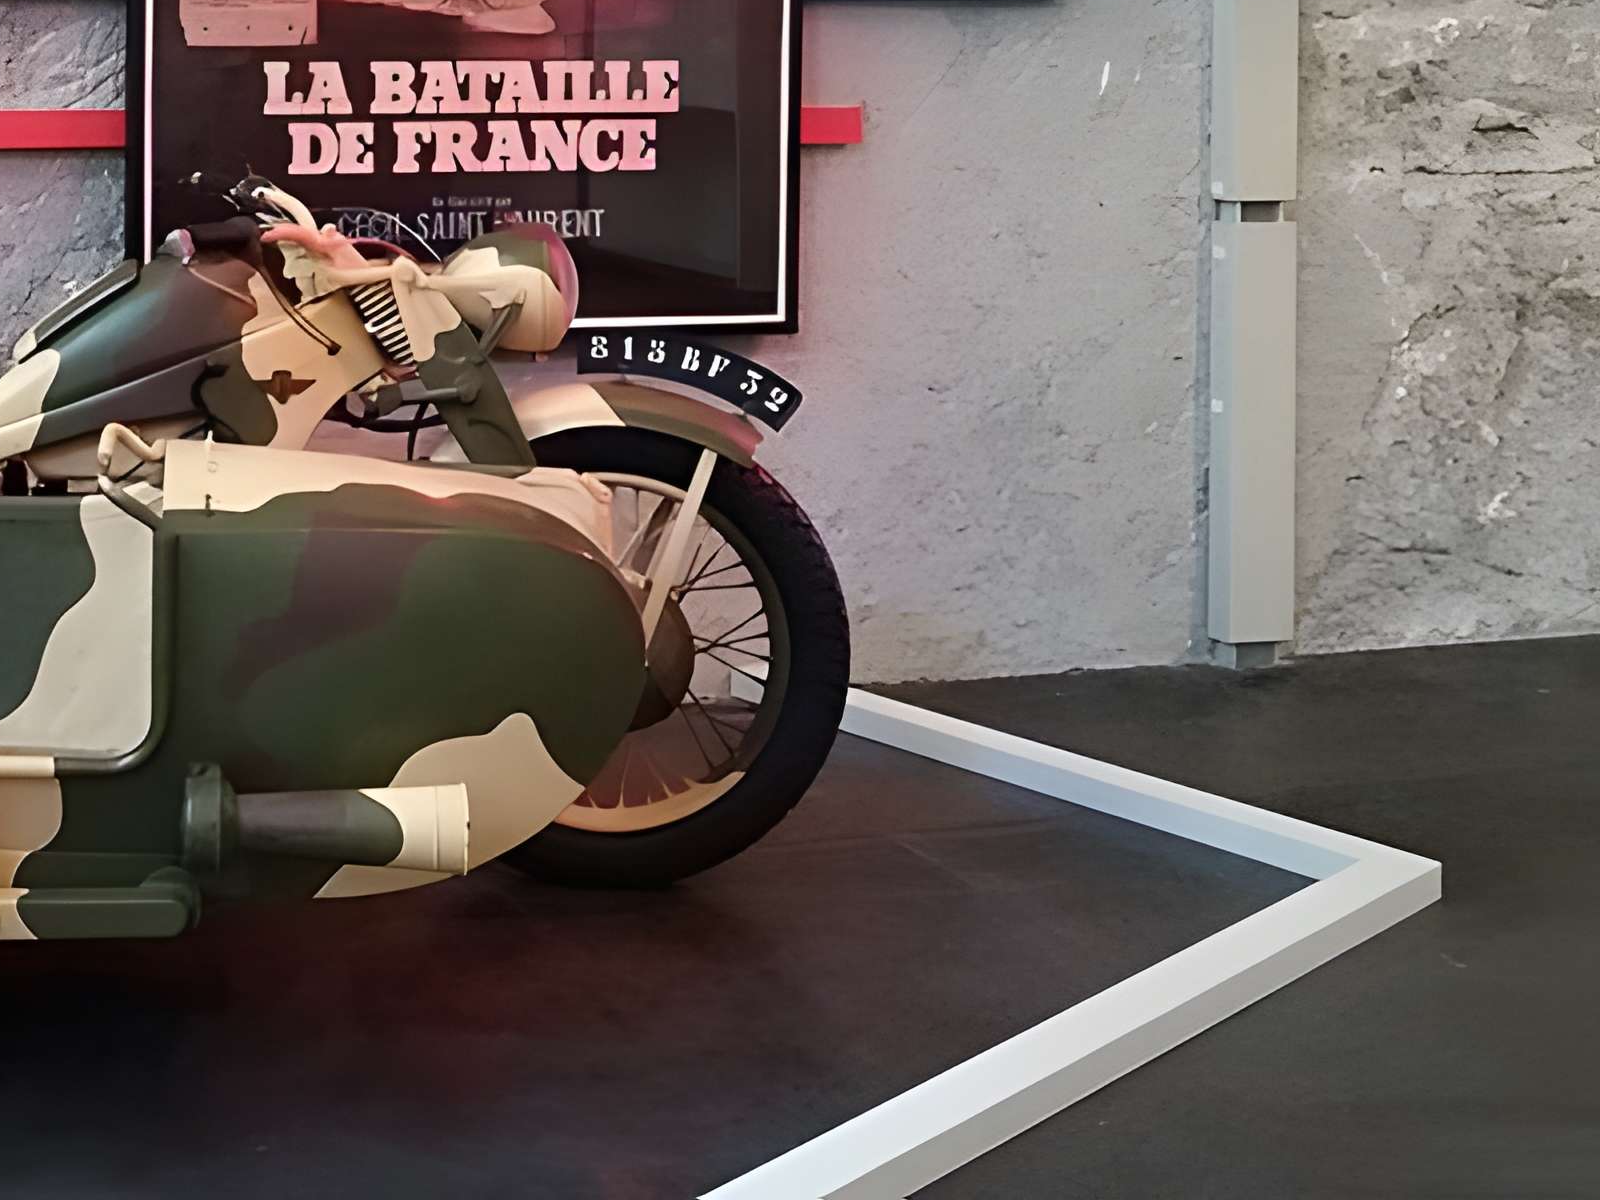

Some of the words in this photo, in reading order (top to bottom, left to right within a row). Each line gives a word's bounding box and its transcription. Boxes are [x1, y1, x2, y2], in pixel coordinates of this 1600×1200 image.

[263, 61, 353, 115] LA
[370, 60, 680, 115] BATAILLE
[287, 121, 375, 175] DE
[392, 119, 657, 174] FRANCE
